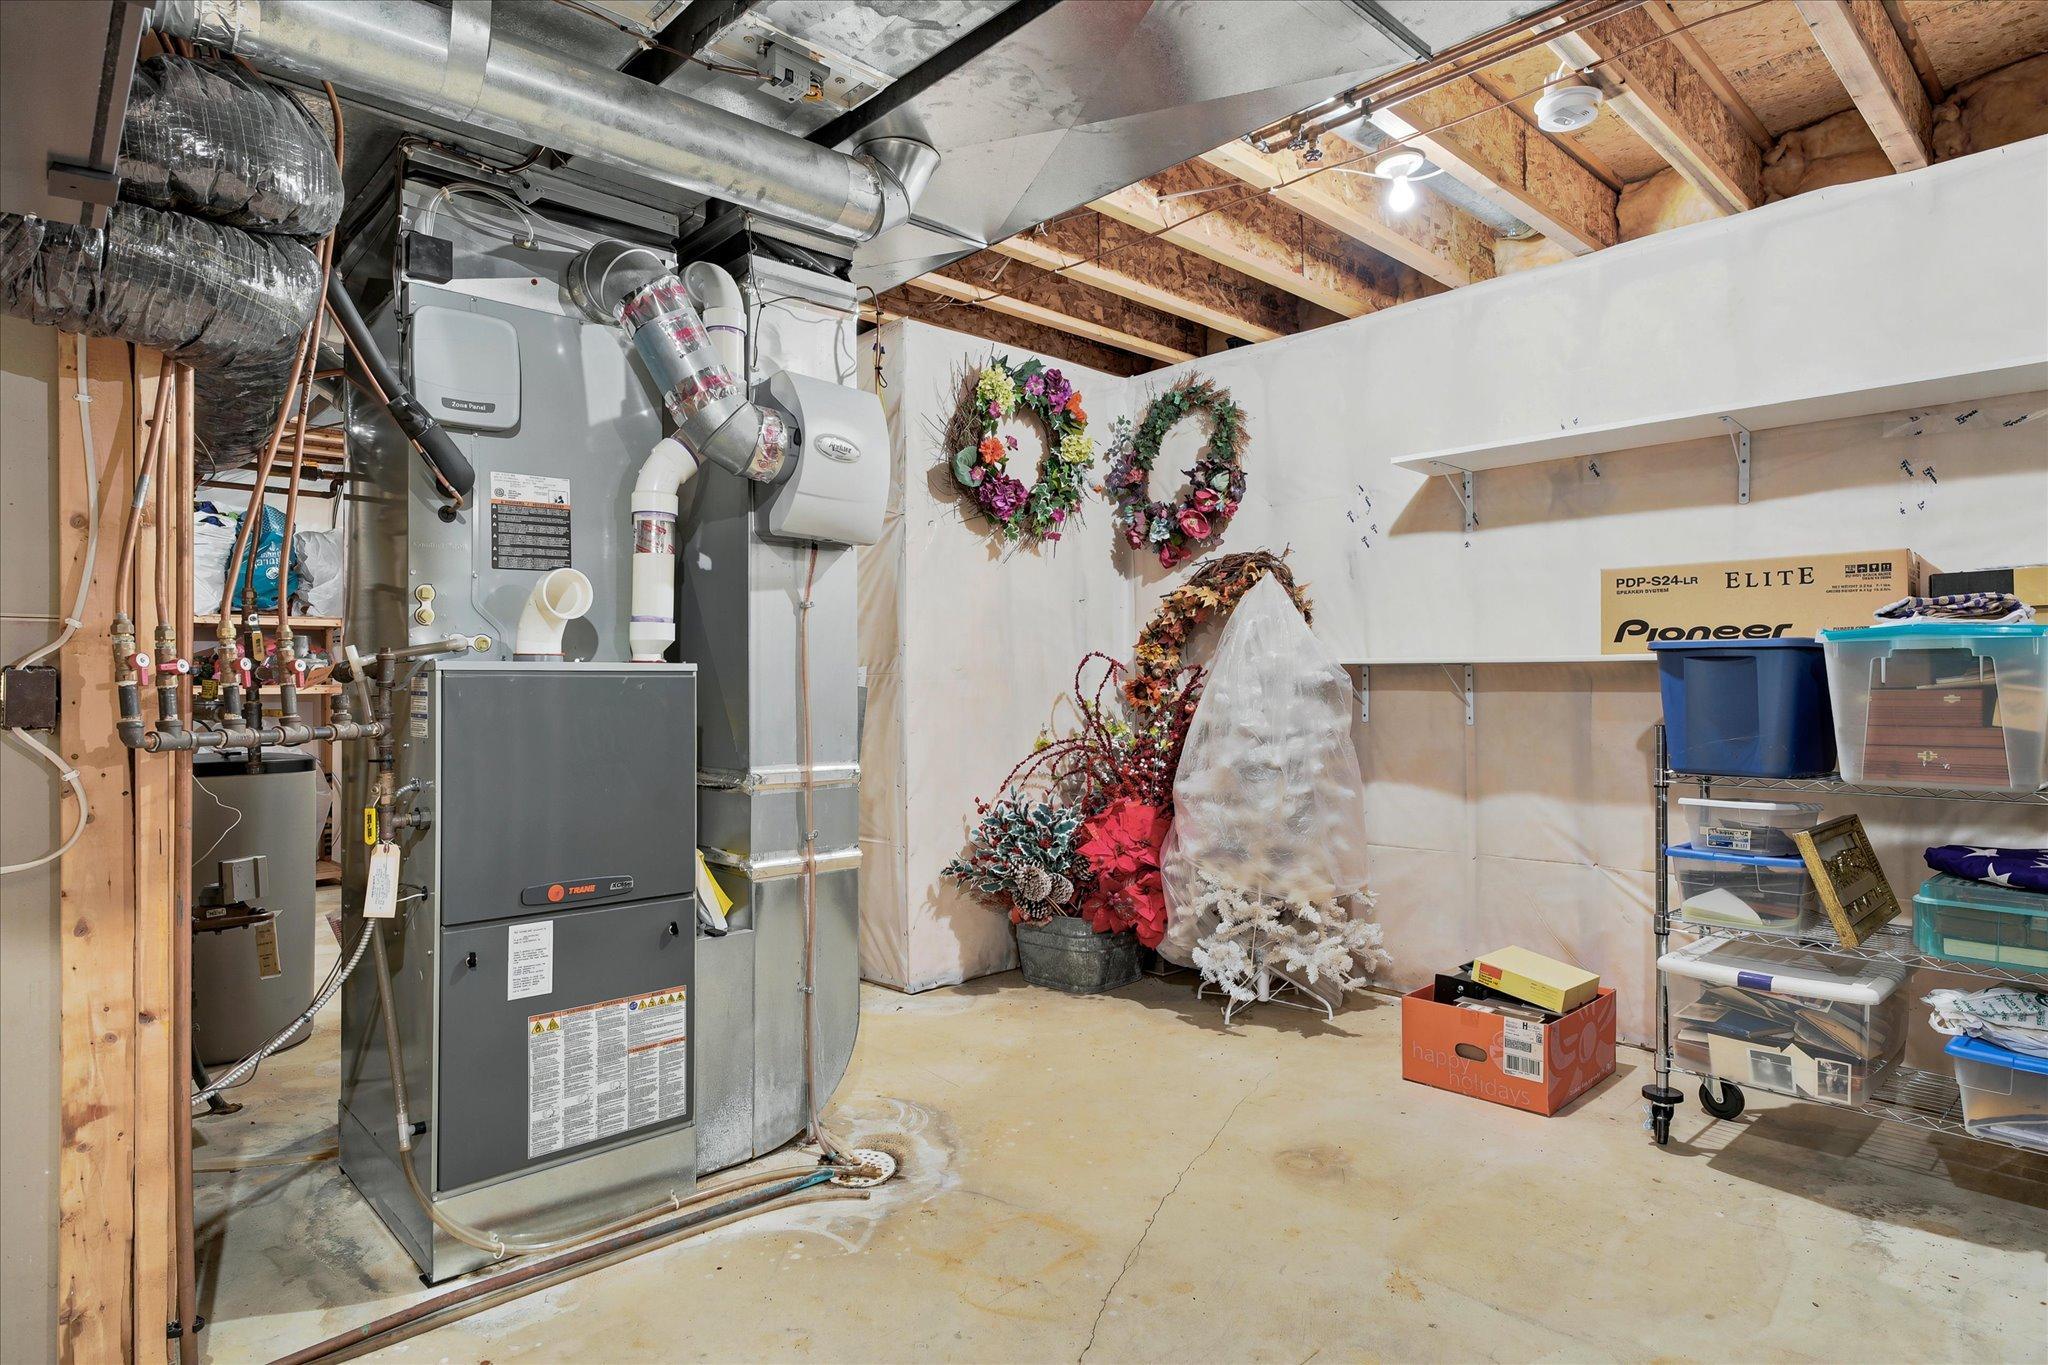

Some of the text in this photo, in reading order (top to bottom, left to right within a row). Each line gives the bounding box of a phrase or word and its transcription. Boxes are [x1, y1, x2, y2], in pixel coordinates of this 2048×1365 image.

[451, 401, 486, 411] Zone Panel
[1616, 575, 1698, 589] PDP-S24-LR
[1724, 566, 1815, 589] ELITE
[1613, 619, 1794, 643] Pioneer
[568, 884, 597, 895] TRANE
[1522, 1022, 1528, 1030] H
[1412, 1040, 1471, 1075] happy
[1449, 1067, 1531, 1106] holidays
